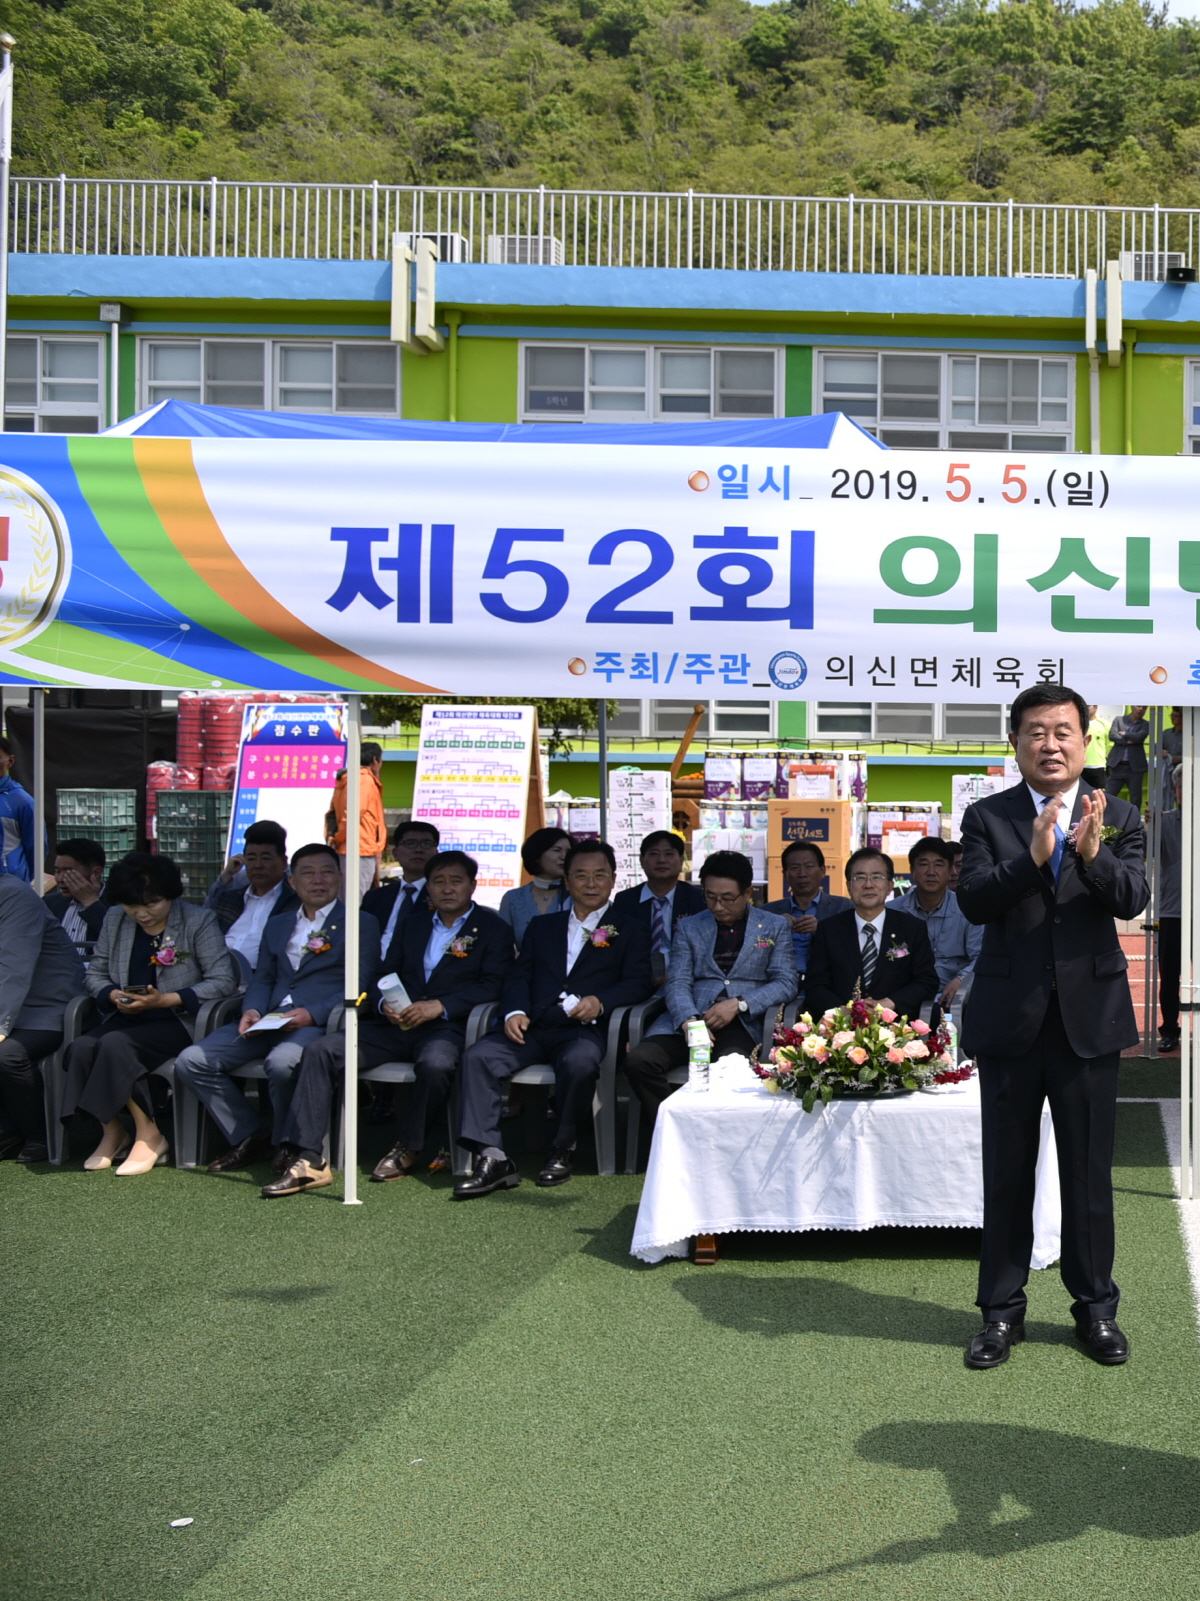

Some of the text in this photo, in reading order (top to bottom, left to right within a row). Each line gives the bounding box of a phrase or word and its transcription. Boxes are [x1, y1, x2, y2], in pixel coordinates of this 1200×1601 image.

[831, 468, 929, 502] 2019.
[945, 462, 986, 503] 5.
[325, 523, 815, 631] 제52회
[824, 655, 1065, 689] 의신면체육회
